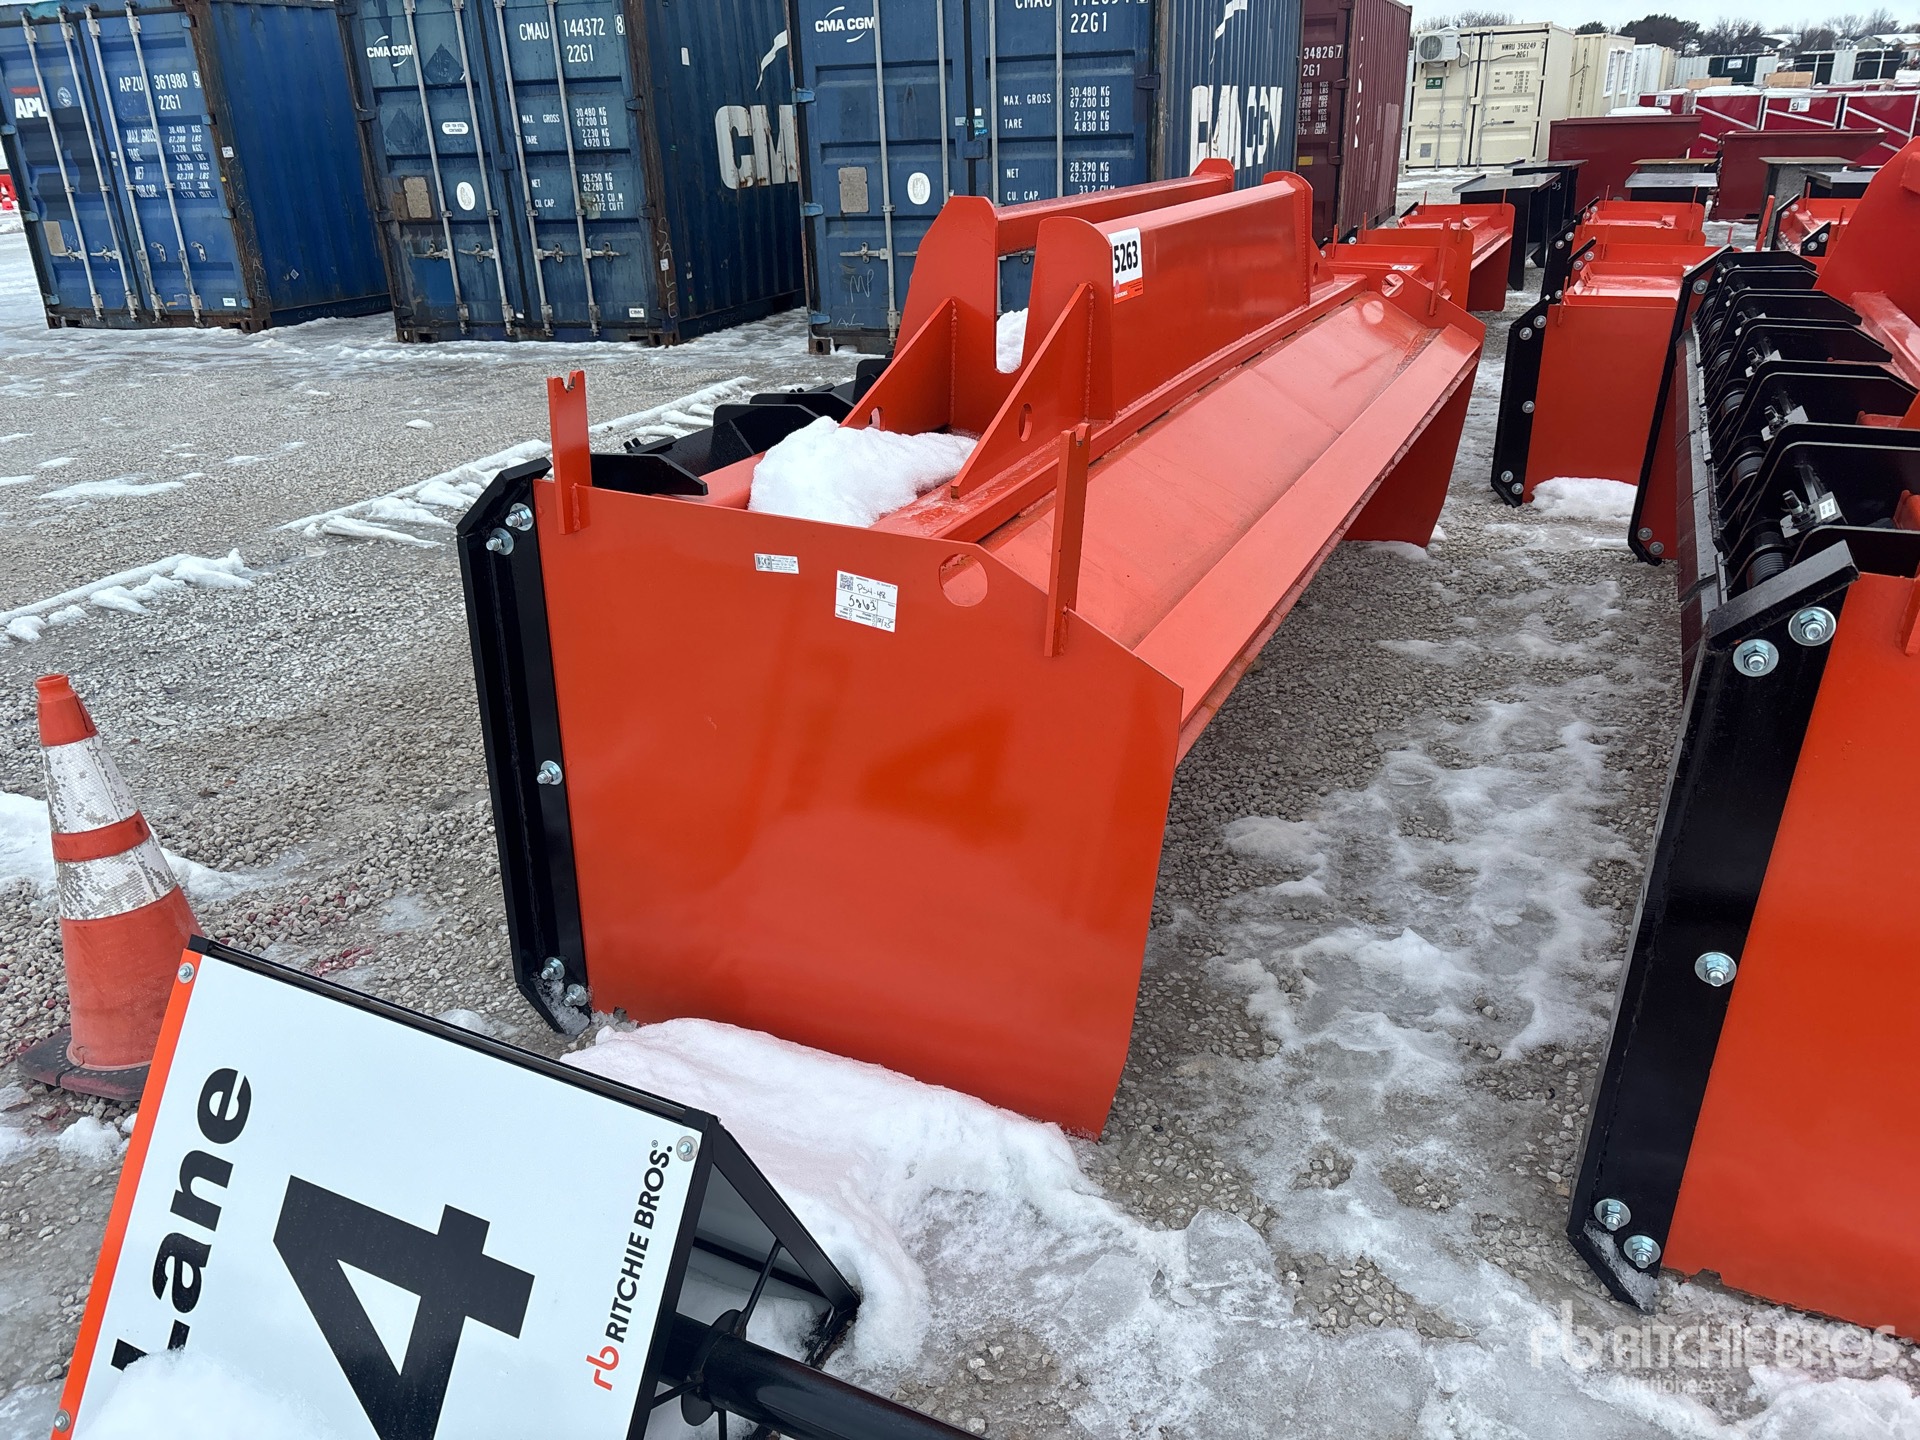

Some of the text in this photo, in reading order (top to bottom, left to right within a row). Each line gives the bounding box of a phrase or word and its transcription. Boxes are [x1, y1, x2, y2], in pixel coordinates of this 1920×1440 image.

[519, 15, 624, 41] CMAU 144372 8
[815, 16, 875, 33] CMA CGM
[1070, 12, 1107, 33] 22G1
[366, 44, 413, 58] CMA CGM
[566, 44, 594, 62] 22G1
[1336, 45, 1343, 58] 7
[119, 72, 200, 92] APZU 361988 9
[159, 94, 181, 110] 22G1
[1003, 86, 1110, 105] MAX. GROSS 30.480 KG
[1069, 97, 1110, 108] 67.200 LB
[15, 97, 48, 118] APL
[522, 107, 607, 123] MAX. GROSS 30.480 KG
[577, 117, 608, 126] 67.200 LB
[1004, 110, 1110, 129] TARE 2.190 KG
[1074, 121, 1110, 132] 4.830 LB
[191, 125, 201, 133] KGS
[525, 128, 610, 145] TARE 2.230 KG
[191, 134, 202, 143] LBS
[584, 138, 611, 148] 4.920 LB
[192, 144, 202, 152] KGS
[199, 163, 209, 171] KGS
[1006, 162, 1110, 179] NET 28.290 KG
[199, 172, 209, 180] LBS
[531, 179, 541, 188] NET
[604, 172, 613, 182] KG
[1070, 172, 1110, 183] 62.370 LB
[583, 182, 614, 191] 62.280 LB
[1007, 191, 1019, 201] CU.
[1024, 190, 1040, 200] CAP.
[1114, 240, 1138, 274] 5263
[605, 1232, 650, 1343] RITCHIE
[273, 1175, 534, 1440] 4
